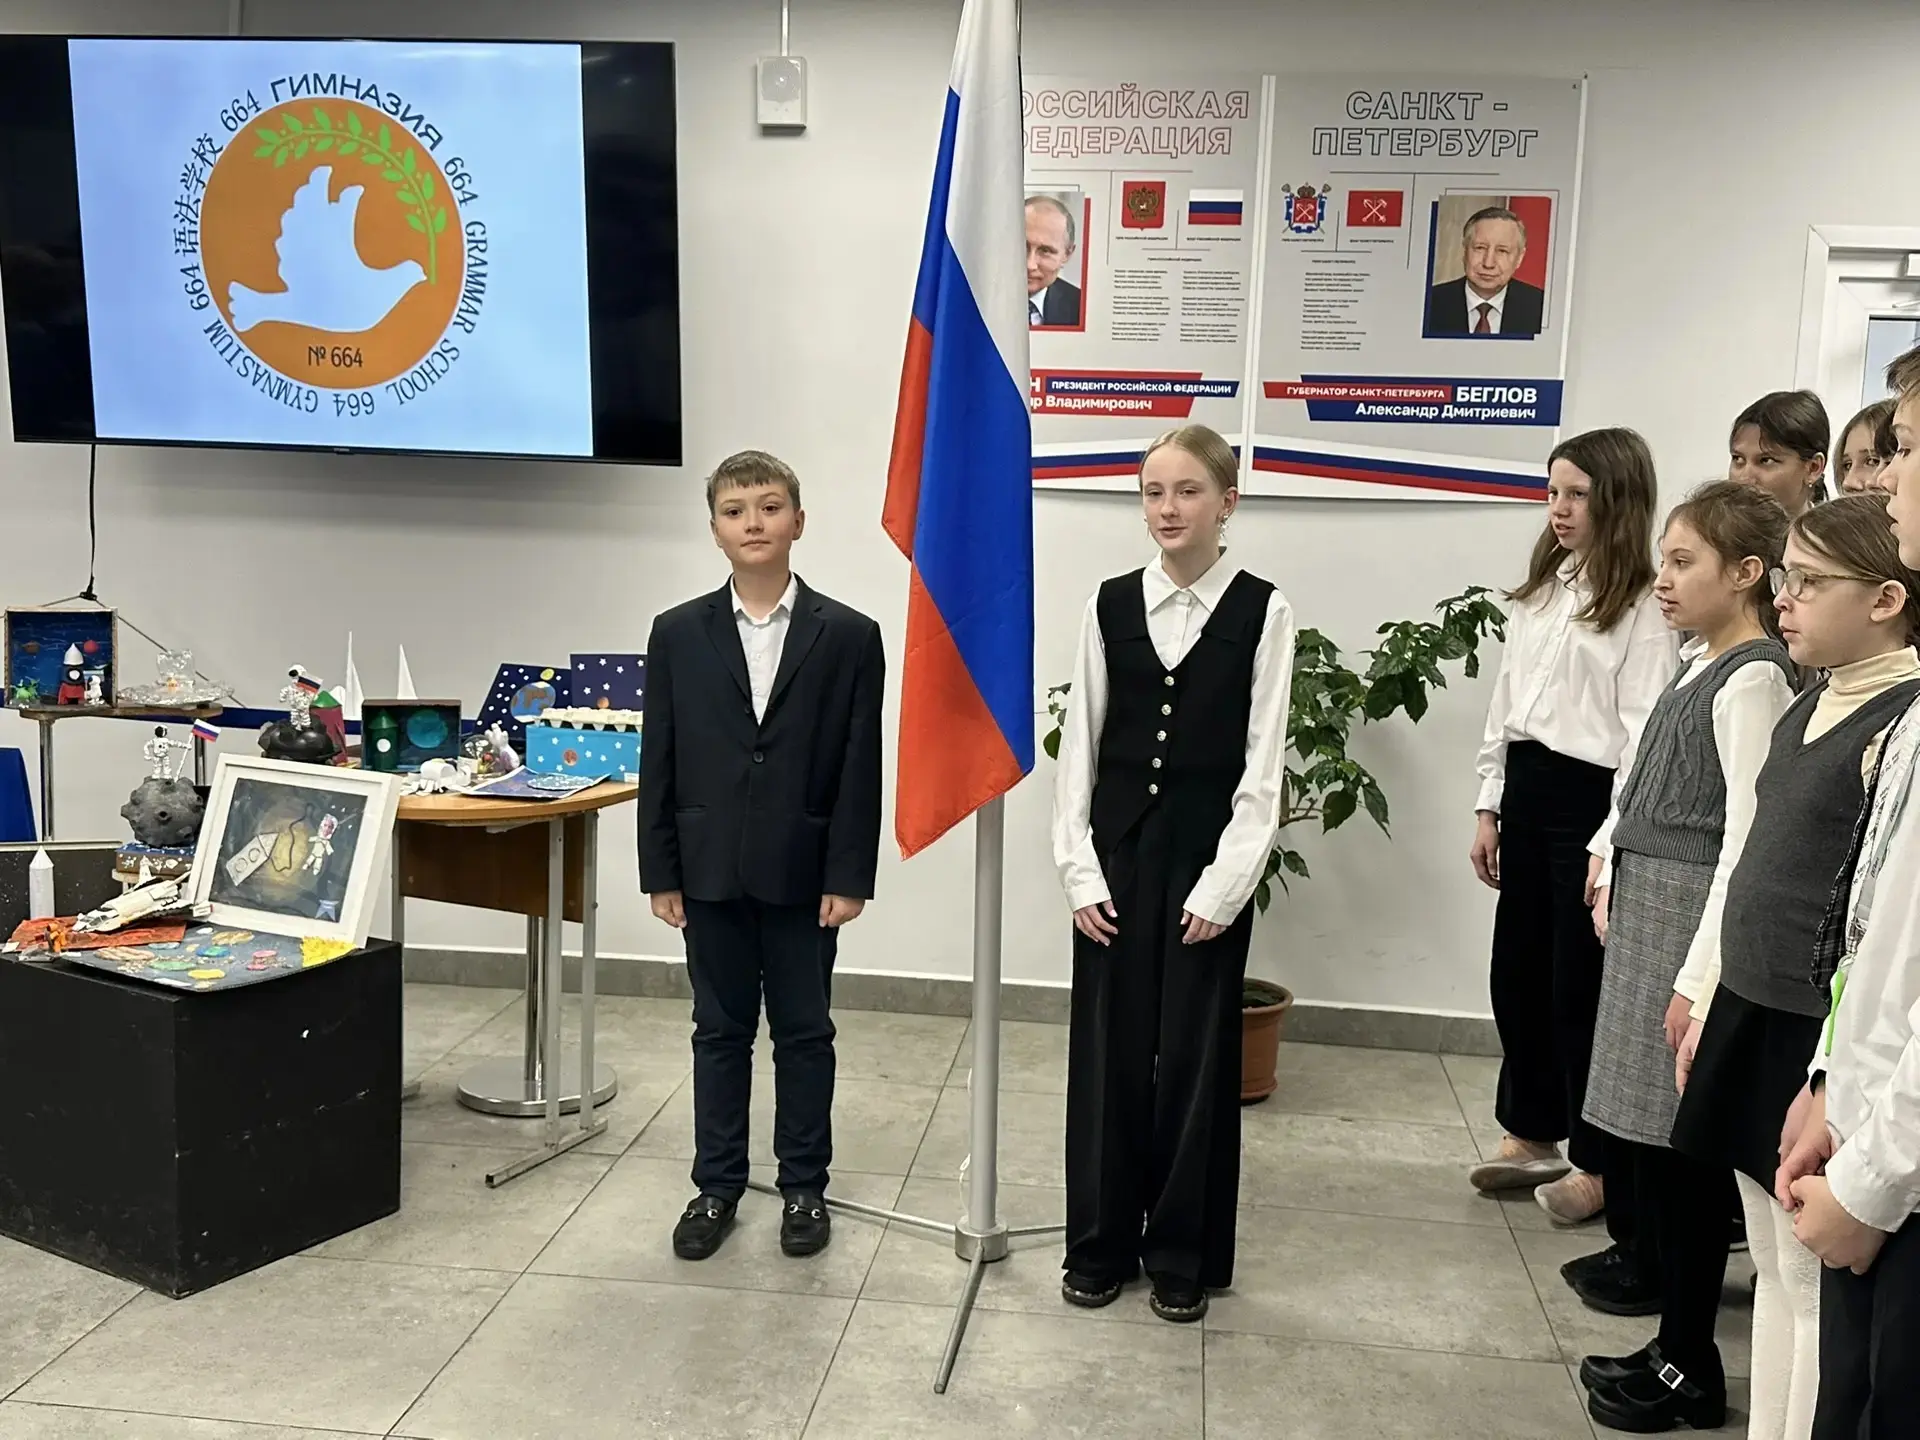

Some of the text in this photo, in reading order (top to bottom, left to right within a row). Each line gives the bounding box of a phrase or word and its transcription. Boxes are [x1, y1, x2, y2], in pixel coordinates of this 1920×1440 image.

[1022, 83, 1249, 119] ОССИЙСКАЯ
[1345, 91, 1483, 120] САНКТ
[270, 73, 479, 208] ГИМНАЗИЯ 664
[1023, 126, 1232, 159] ЕДЕРАЦИЯ
[1312, 127, 1538, 158] ПЕТЕРБУРГ
[173, 89, 262, 257] 语法学校 664
[332, 220, 488, 417] GRAMMAR SCHOOL 664
[180, 262, 319, 413] GYMNASIUM 664
[331, 346, 363, 368] 664
[1051, 380, 1106, 392] ПРЕЗИДЕНТ
[1107, 381, 1172, 393] РОССИЙСКОЙ
[1173, 383, 1232, 394] ФЕДЕРАЦИИ
[1286, 386, 1445, 398] ГУБЕРНАТОР САНКТ-ПЕТЕРБУРГА
[1456, 386, 1537, 403] БЕГЛОВ
[1045, 394, 1152, 411] Владимирович
[1355, 402, 1536, 420] Александр Дмитриевич
